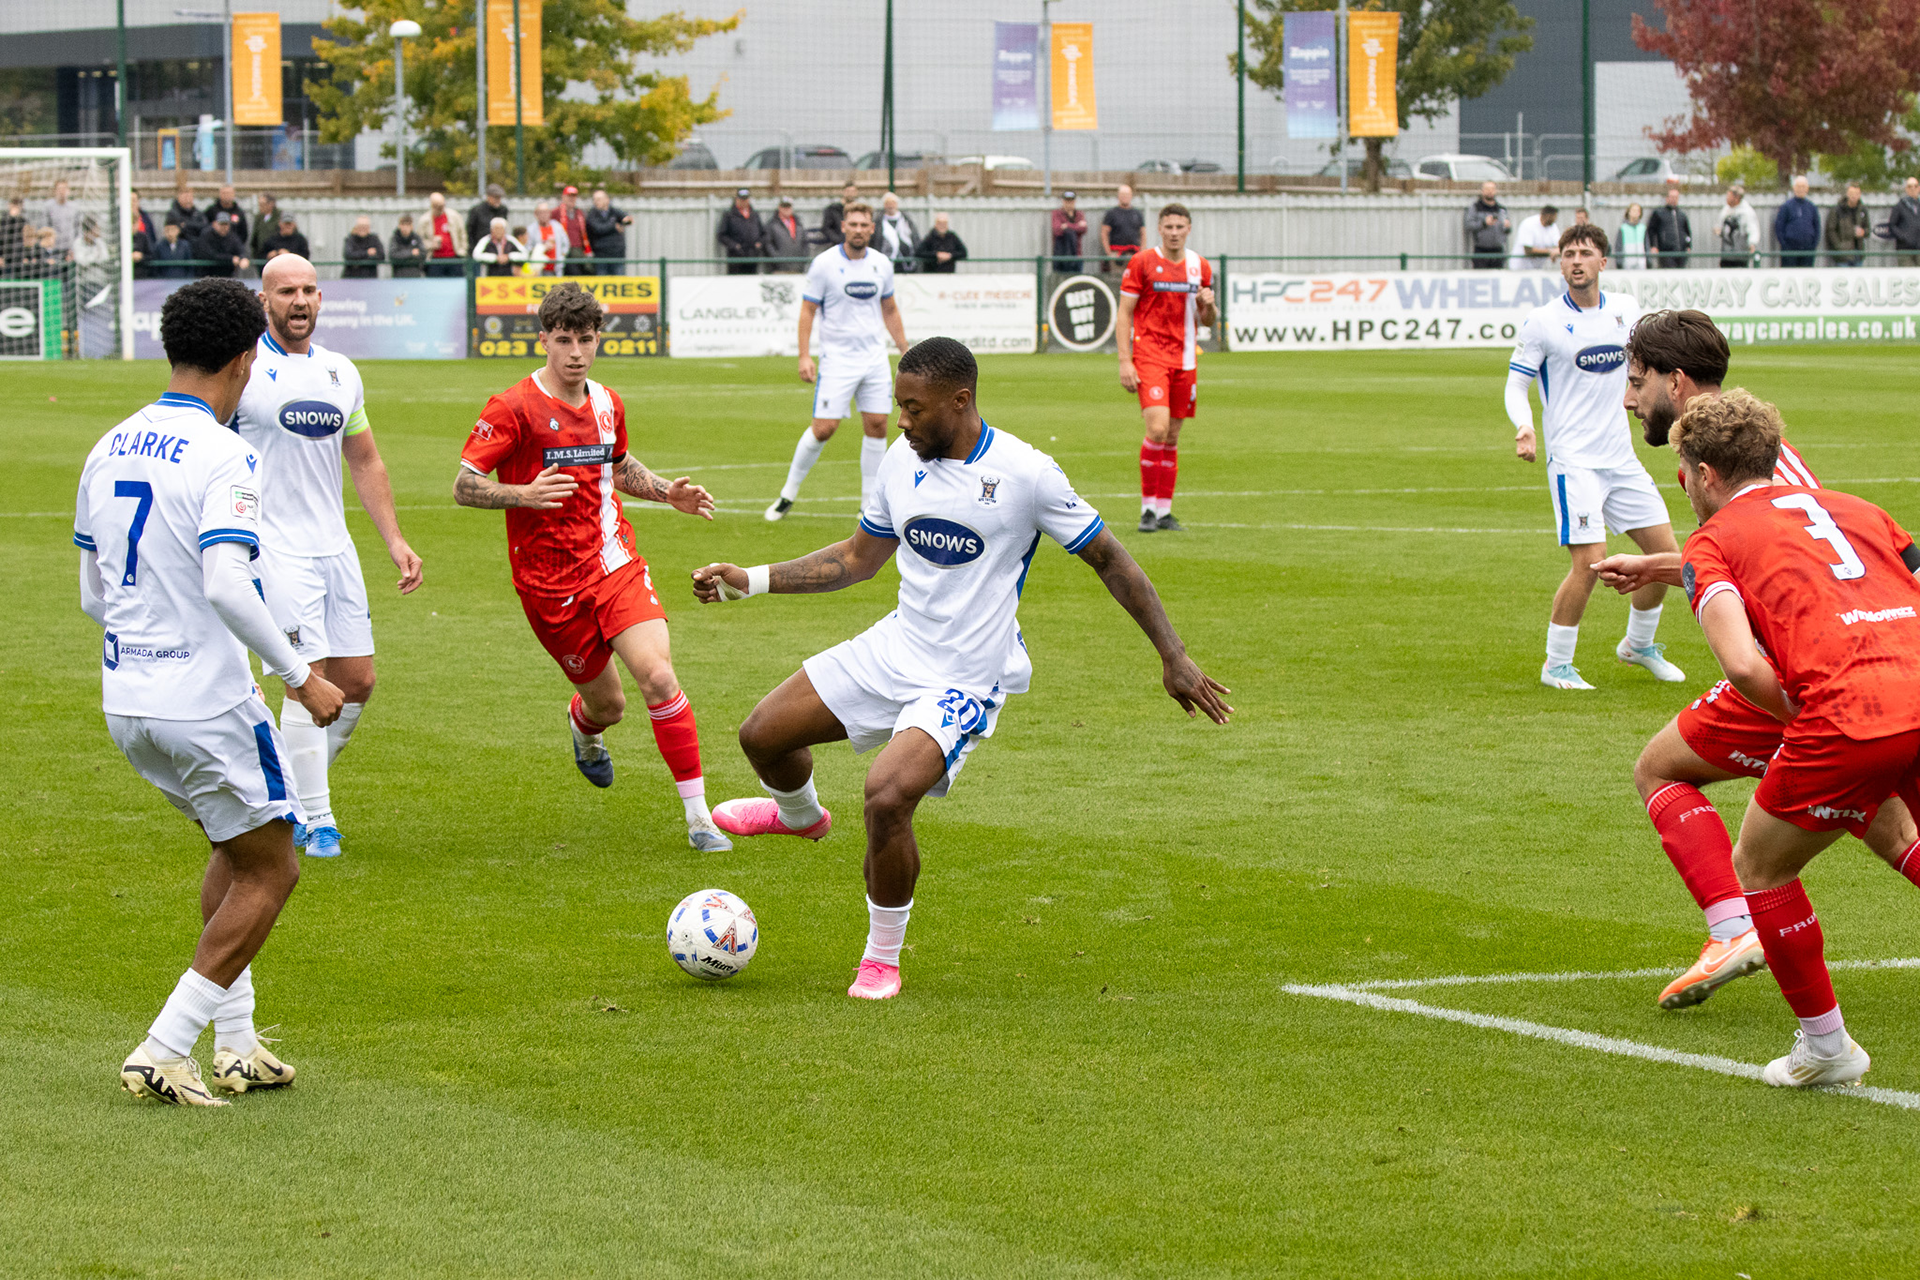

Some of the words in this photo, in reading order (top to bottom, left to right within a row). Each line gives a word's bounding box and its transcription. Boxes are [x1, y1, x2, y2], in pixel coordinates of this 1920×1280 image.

[1232, 279, 1389, 303] HPC247
[1760, 277, 1822, 308] CAR
[1831, 277, 1920, 307] SALES
[679, 307, 770, 321] LANGLEY
[1235, 318, 1516, 343] www.HPC247.co
[1716, 316, 1917, 345] waycarsales.co.uk
[480, 340, 528, 356] 023
[603, 339, 657, 355] 0211
[1580, 350, 1624, 367] SNOWS
[285, 411, 341, 428] SNOWS
[108, 430, 190, 464] CLARKE
[114, 480, 154, 586] 7
[909, 528, 978, 555] SNOWS
[1770, 492, 1867, 580] 3
[120, 647, 153, 658] ARMADA
[155, 650, 190, 659] GROUP
[937, 688, 980, 731] 20
[1779, 911, 1816, 937] FRO
[700, 955, 734, 971] Mitre
